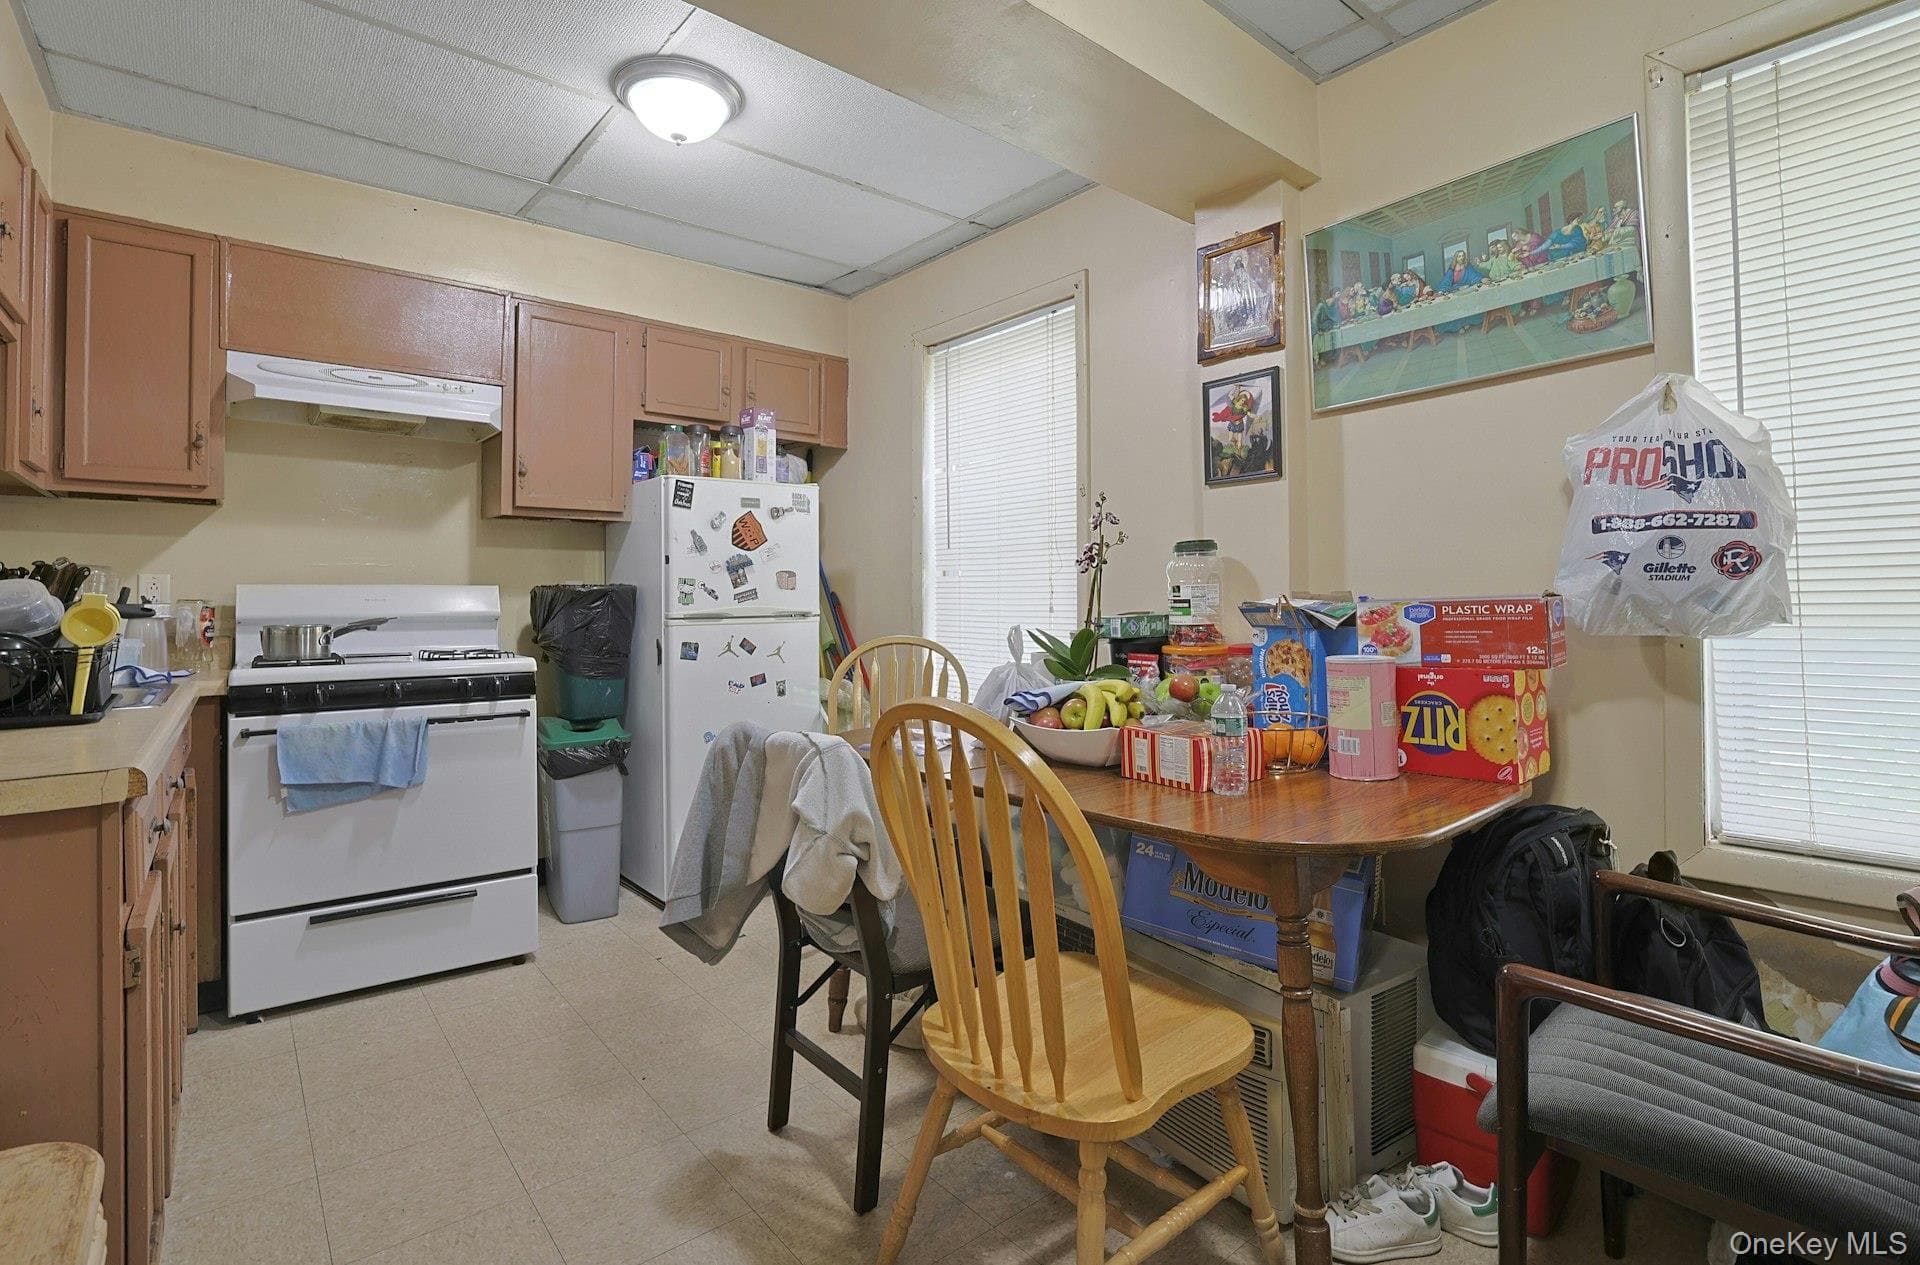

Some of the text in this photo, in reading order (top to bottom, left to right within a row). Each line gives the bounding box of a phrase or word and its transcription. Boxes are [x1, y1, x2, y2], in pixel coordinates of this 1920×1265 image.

[1600, 513, 1740, 531] 1-888-662-7287
[1643, 562, 1697, 574] Gillette
[1441, 604, 1533, 615] PLASTIC WRAP
[1417, 671, 1444, 681] original
[1401, 705, 1467, 751] RITZ
[1136, 843, 1154, 857] 24
[1187, 909, 1256, 941] Especial
